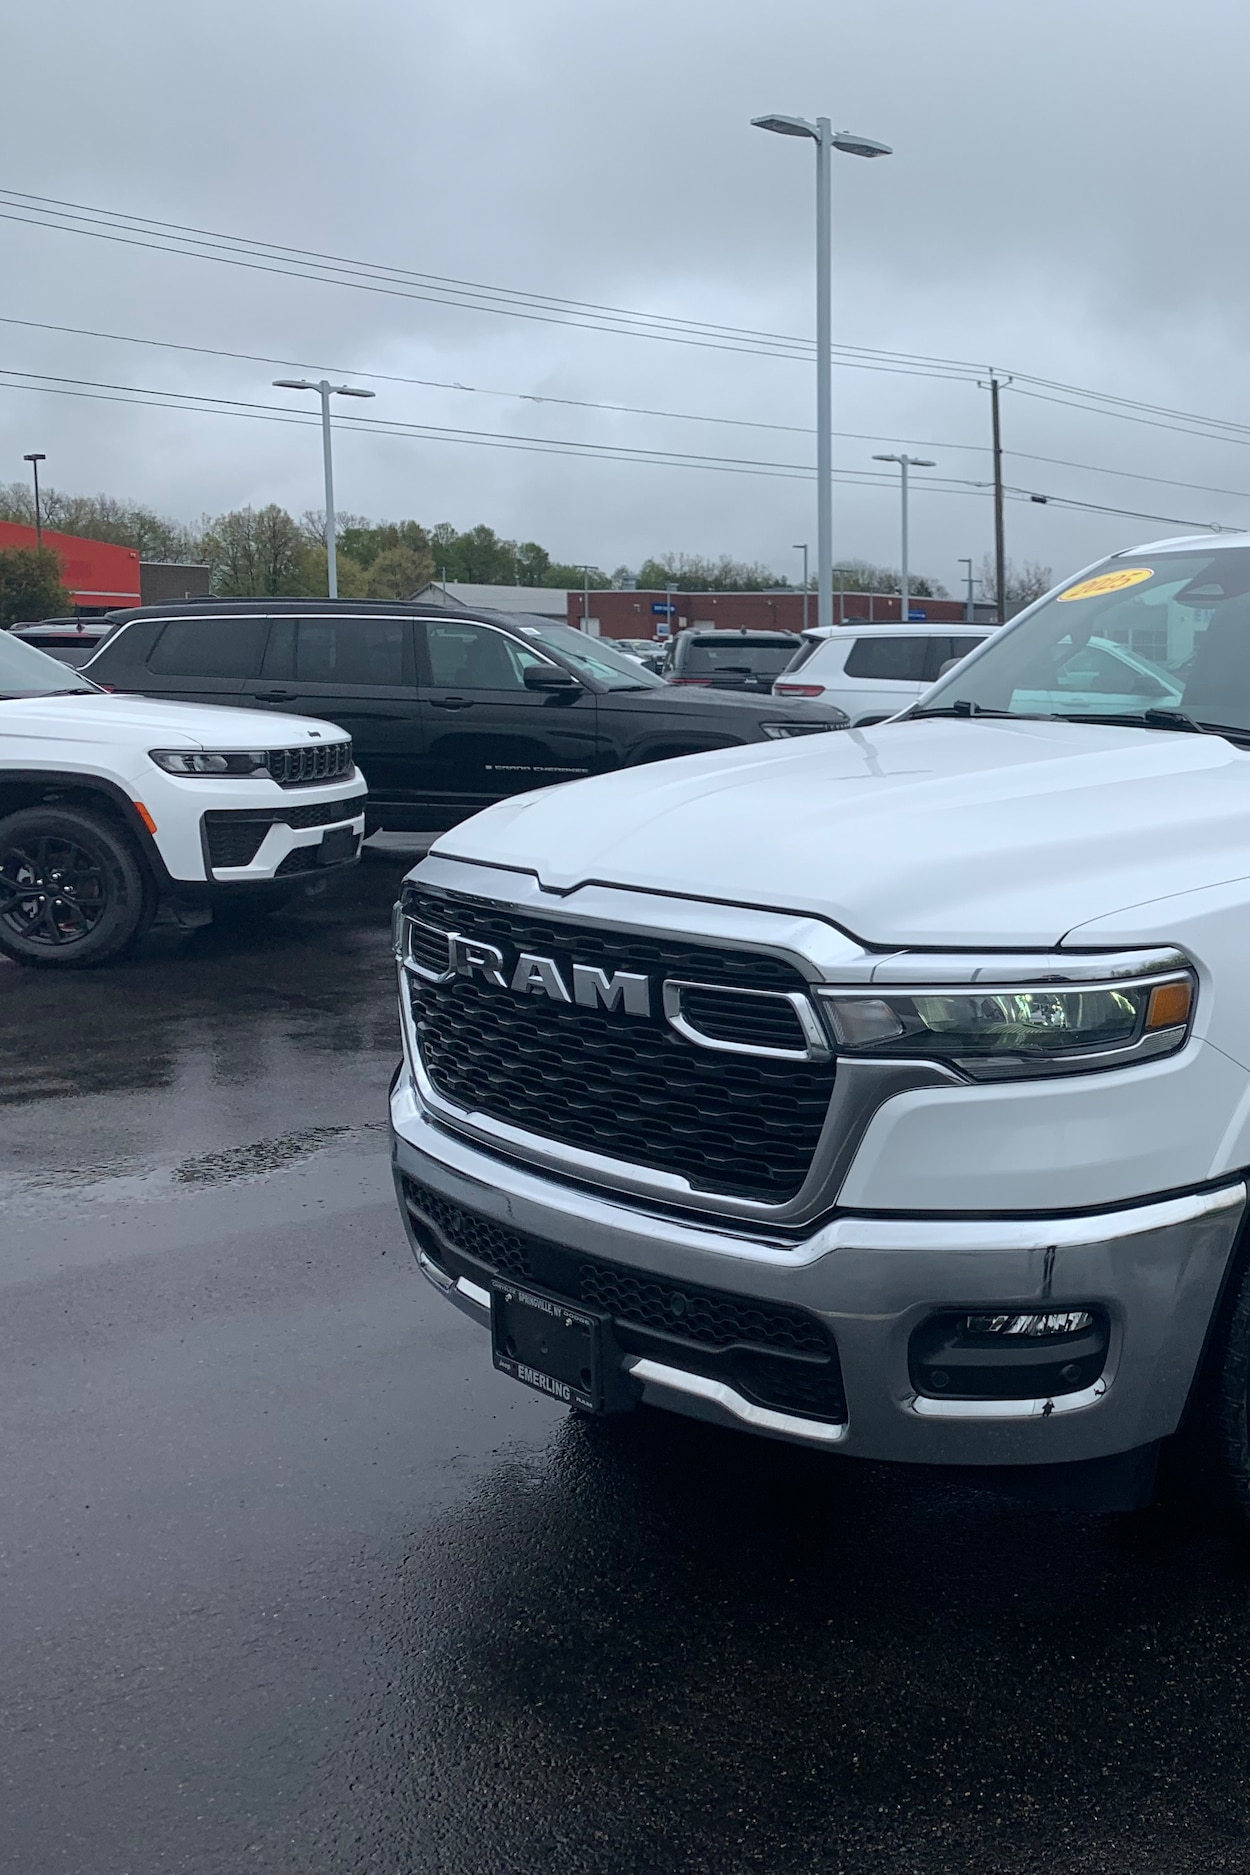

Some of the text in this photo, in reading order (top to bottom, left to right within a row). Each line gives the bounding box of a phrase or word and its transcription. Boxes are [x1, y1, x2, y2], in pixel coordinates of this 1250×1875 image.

[1067, 571, 1143, 598] 2025
[448, 933, 651, 1017] RAM
[562, 1310, 591, 1326] DODGE
[517, 1364, 571, 1401] EMERLING
[576, 1396, 593, 1408] RAM
